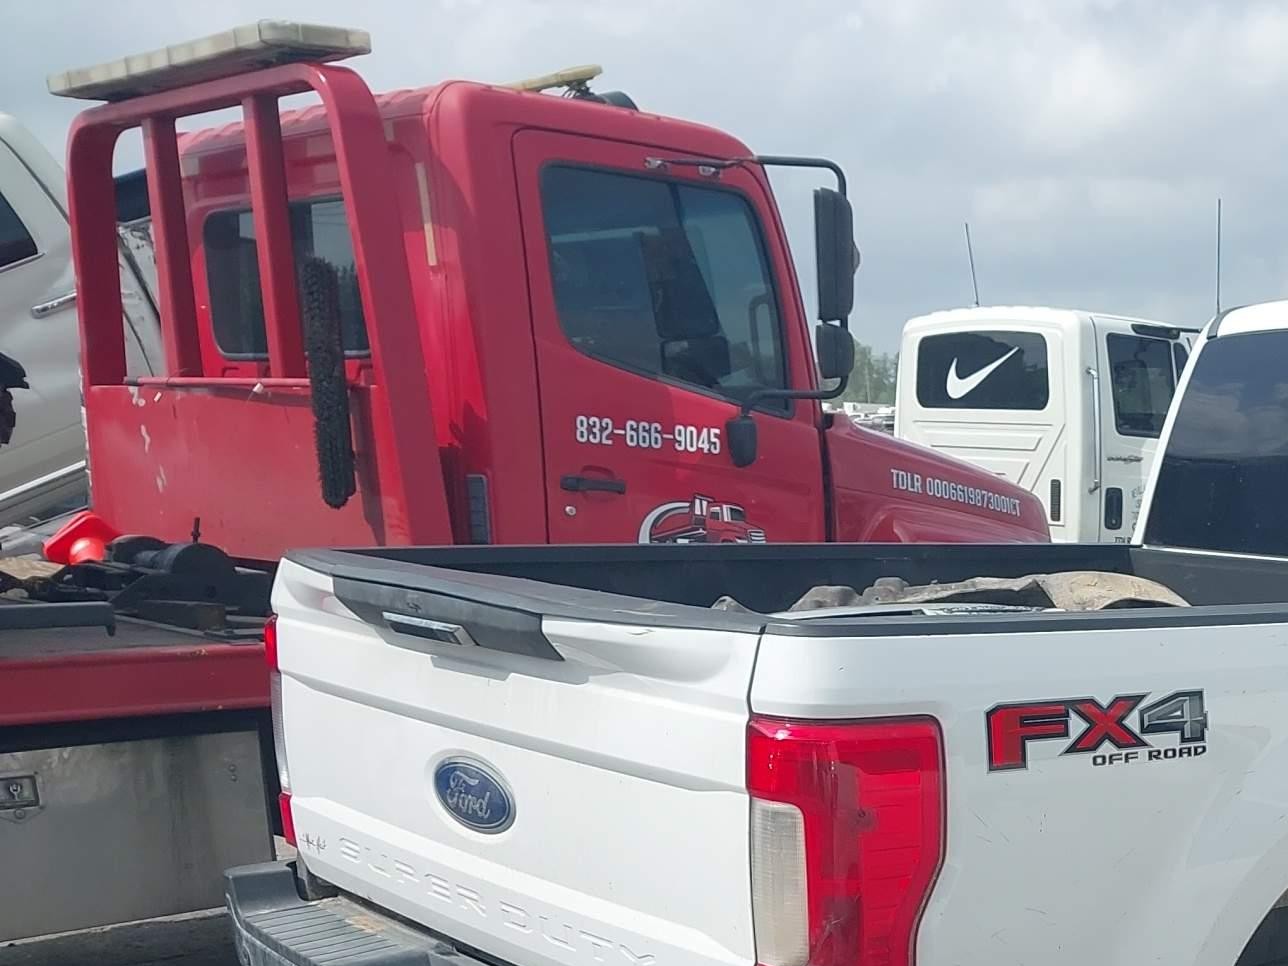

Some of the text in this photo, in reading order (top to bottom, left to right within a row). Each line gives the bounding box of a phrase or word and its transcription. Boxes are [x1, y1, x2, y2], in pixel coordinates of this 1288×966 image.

[576, 415, 721, 454] 832-666-9045
[891, 469, 1021, 517] TDLR 0006619873001CT
[985, 688, 1209, 773] FX4
[1092, 745, 1208, 767] OFF ROAD
[446, 770, 492, 819] Ford
[339, 837, 487, 917] SUPER
